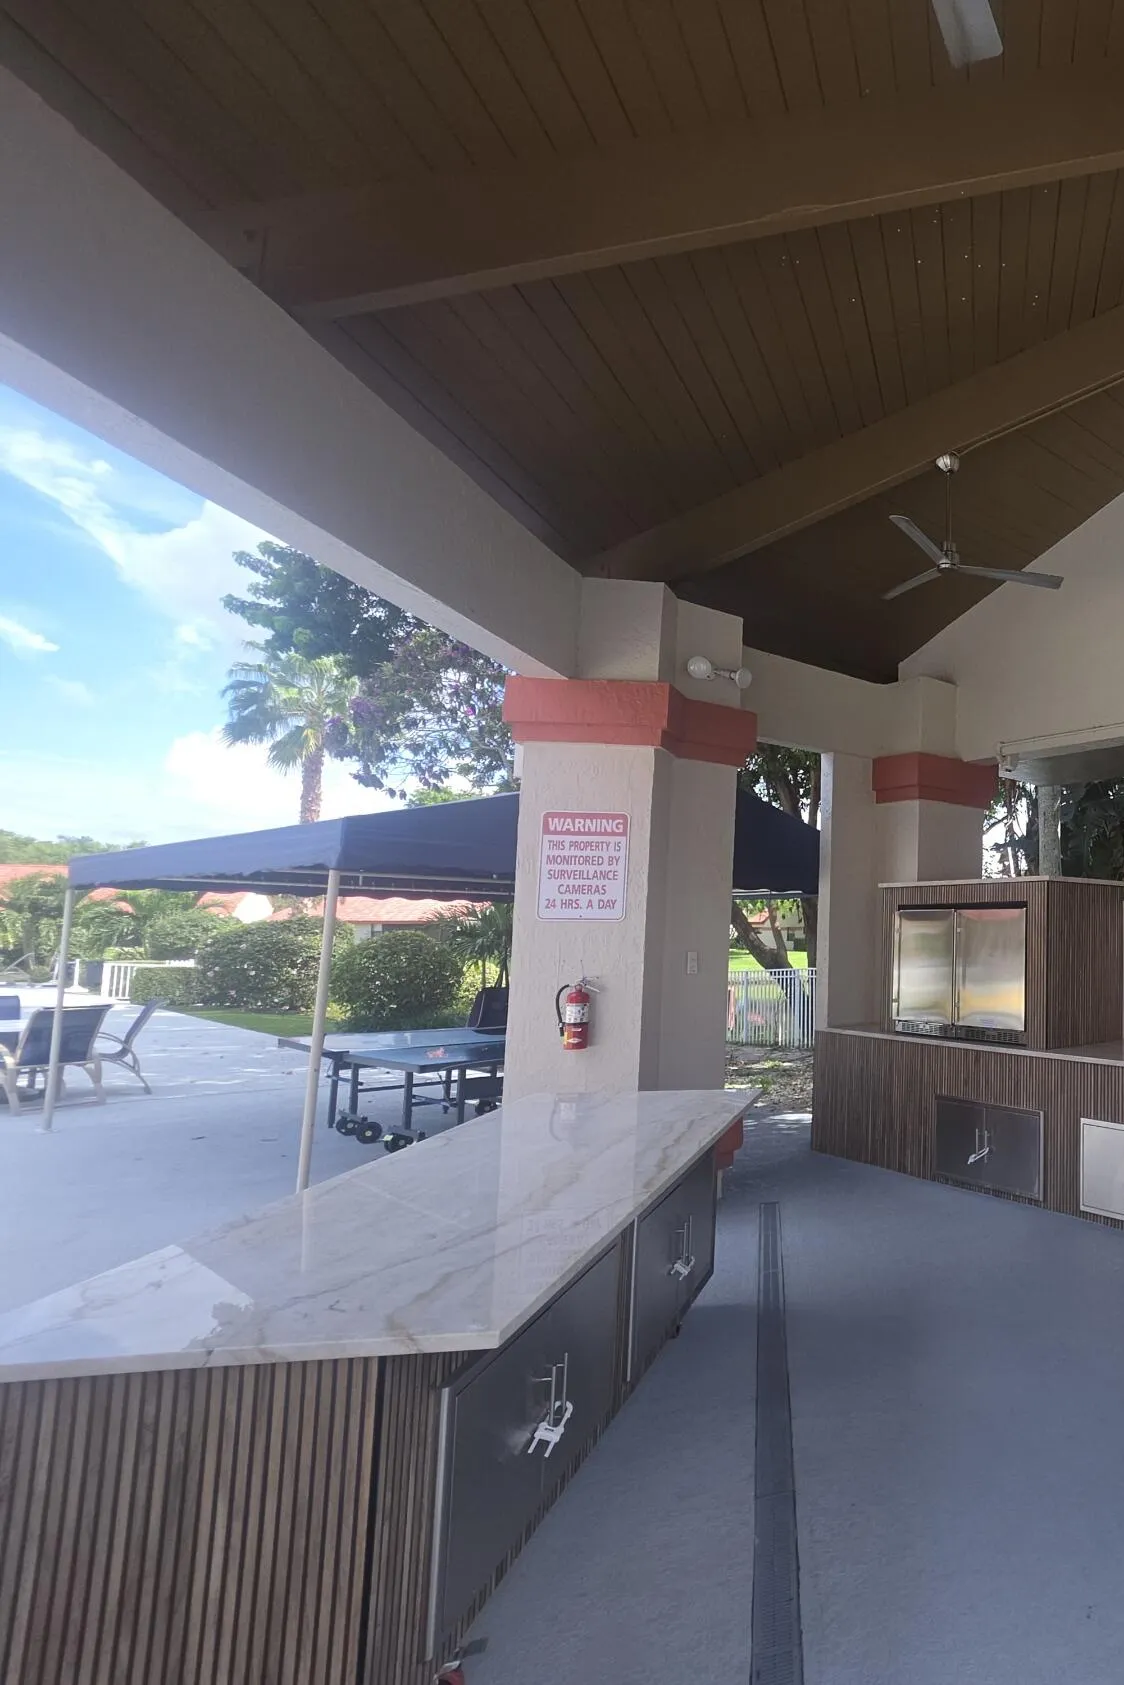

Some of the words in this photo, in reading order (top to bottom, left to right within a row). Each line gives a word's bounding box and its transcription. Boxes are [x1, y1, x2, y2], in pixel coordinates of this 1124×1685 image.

[548, 817, 624, 833] WARNING
[548, 840, 565, 851] THIS
[568, 841, 611, 852] PROPERTY
[614, 841, 621, 852] IS
[546, 855, 604, 866] MONITORED
[608, 856, 620, 867] BY
[547, 869, 618, 881] SURVEILLANCE
[557, 884, 607, 895] CAMERAS
[545, 898, 556, 910] 24
[586, 899, 594, 910] A
[598, 899, 617, 911] DAY
